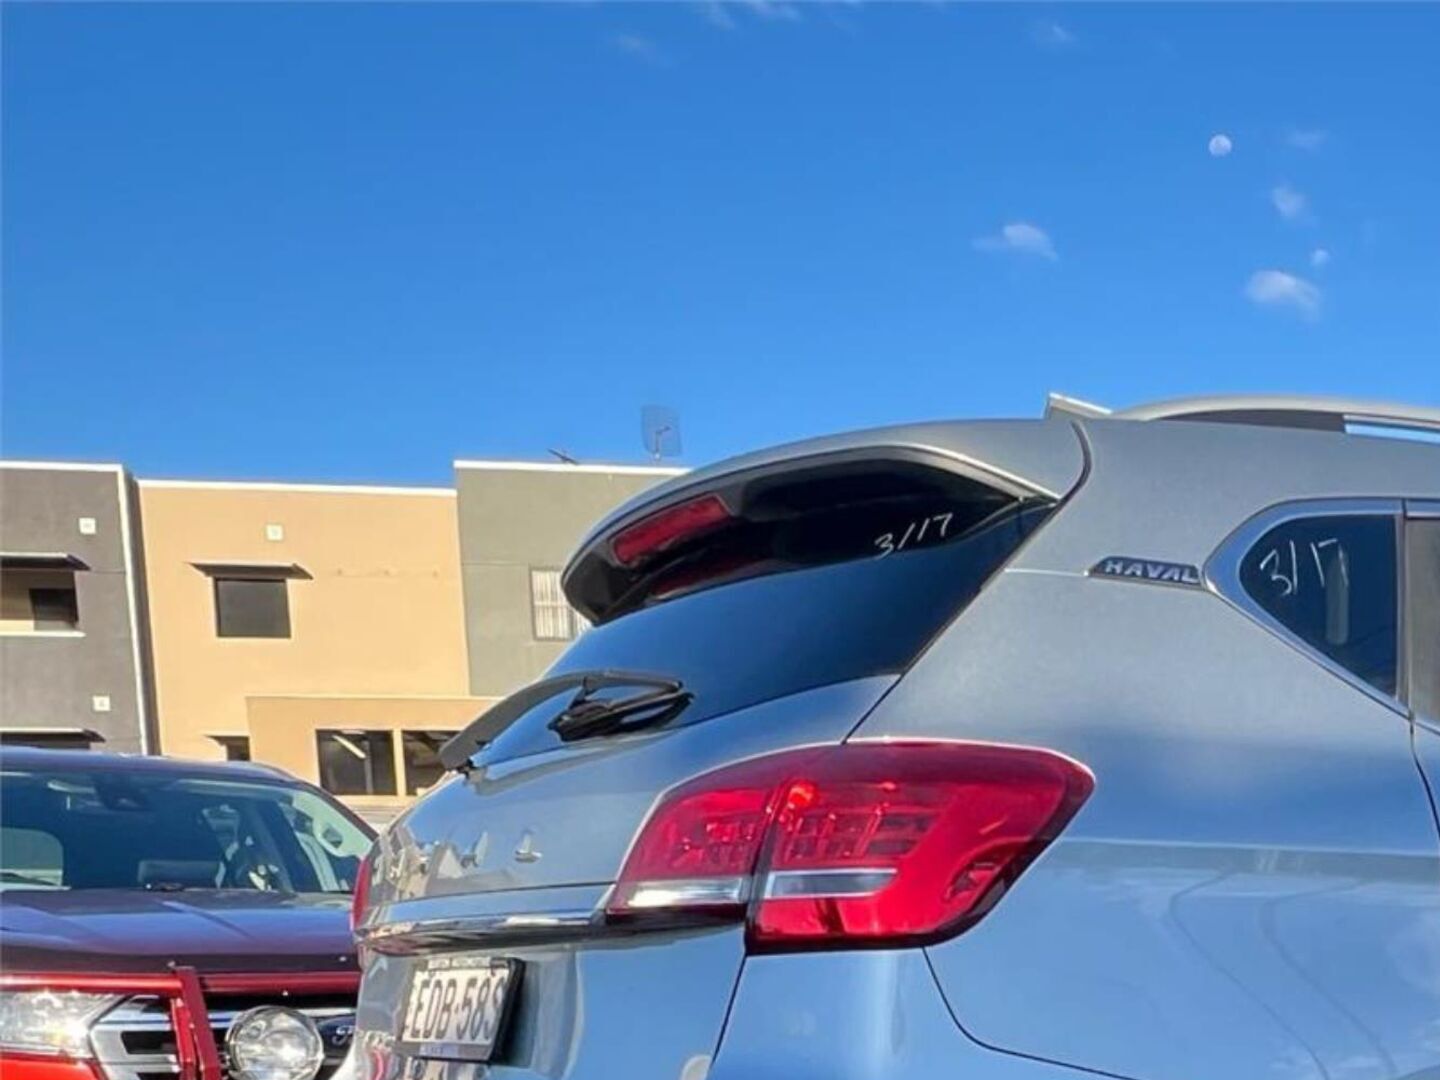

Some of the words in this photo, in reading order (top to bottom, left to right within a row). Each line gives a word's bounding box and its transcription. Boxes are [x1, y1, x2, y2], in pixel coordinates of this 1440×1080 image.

[875, 513, 953, 556] 3/17
[1104, 560, 1199, 583] HAVAL
[1259, 537, 1350, 596] 3/17
